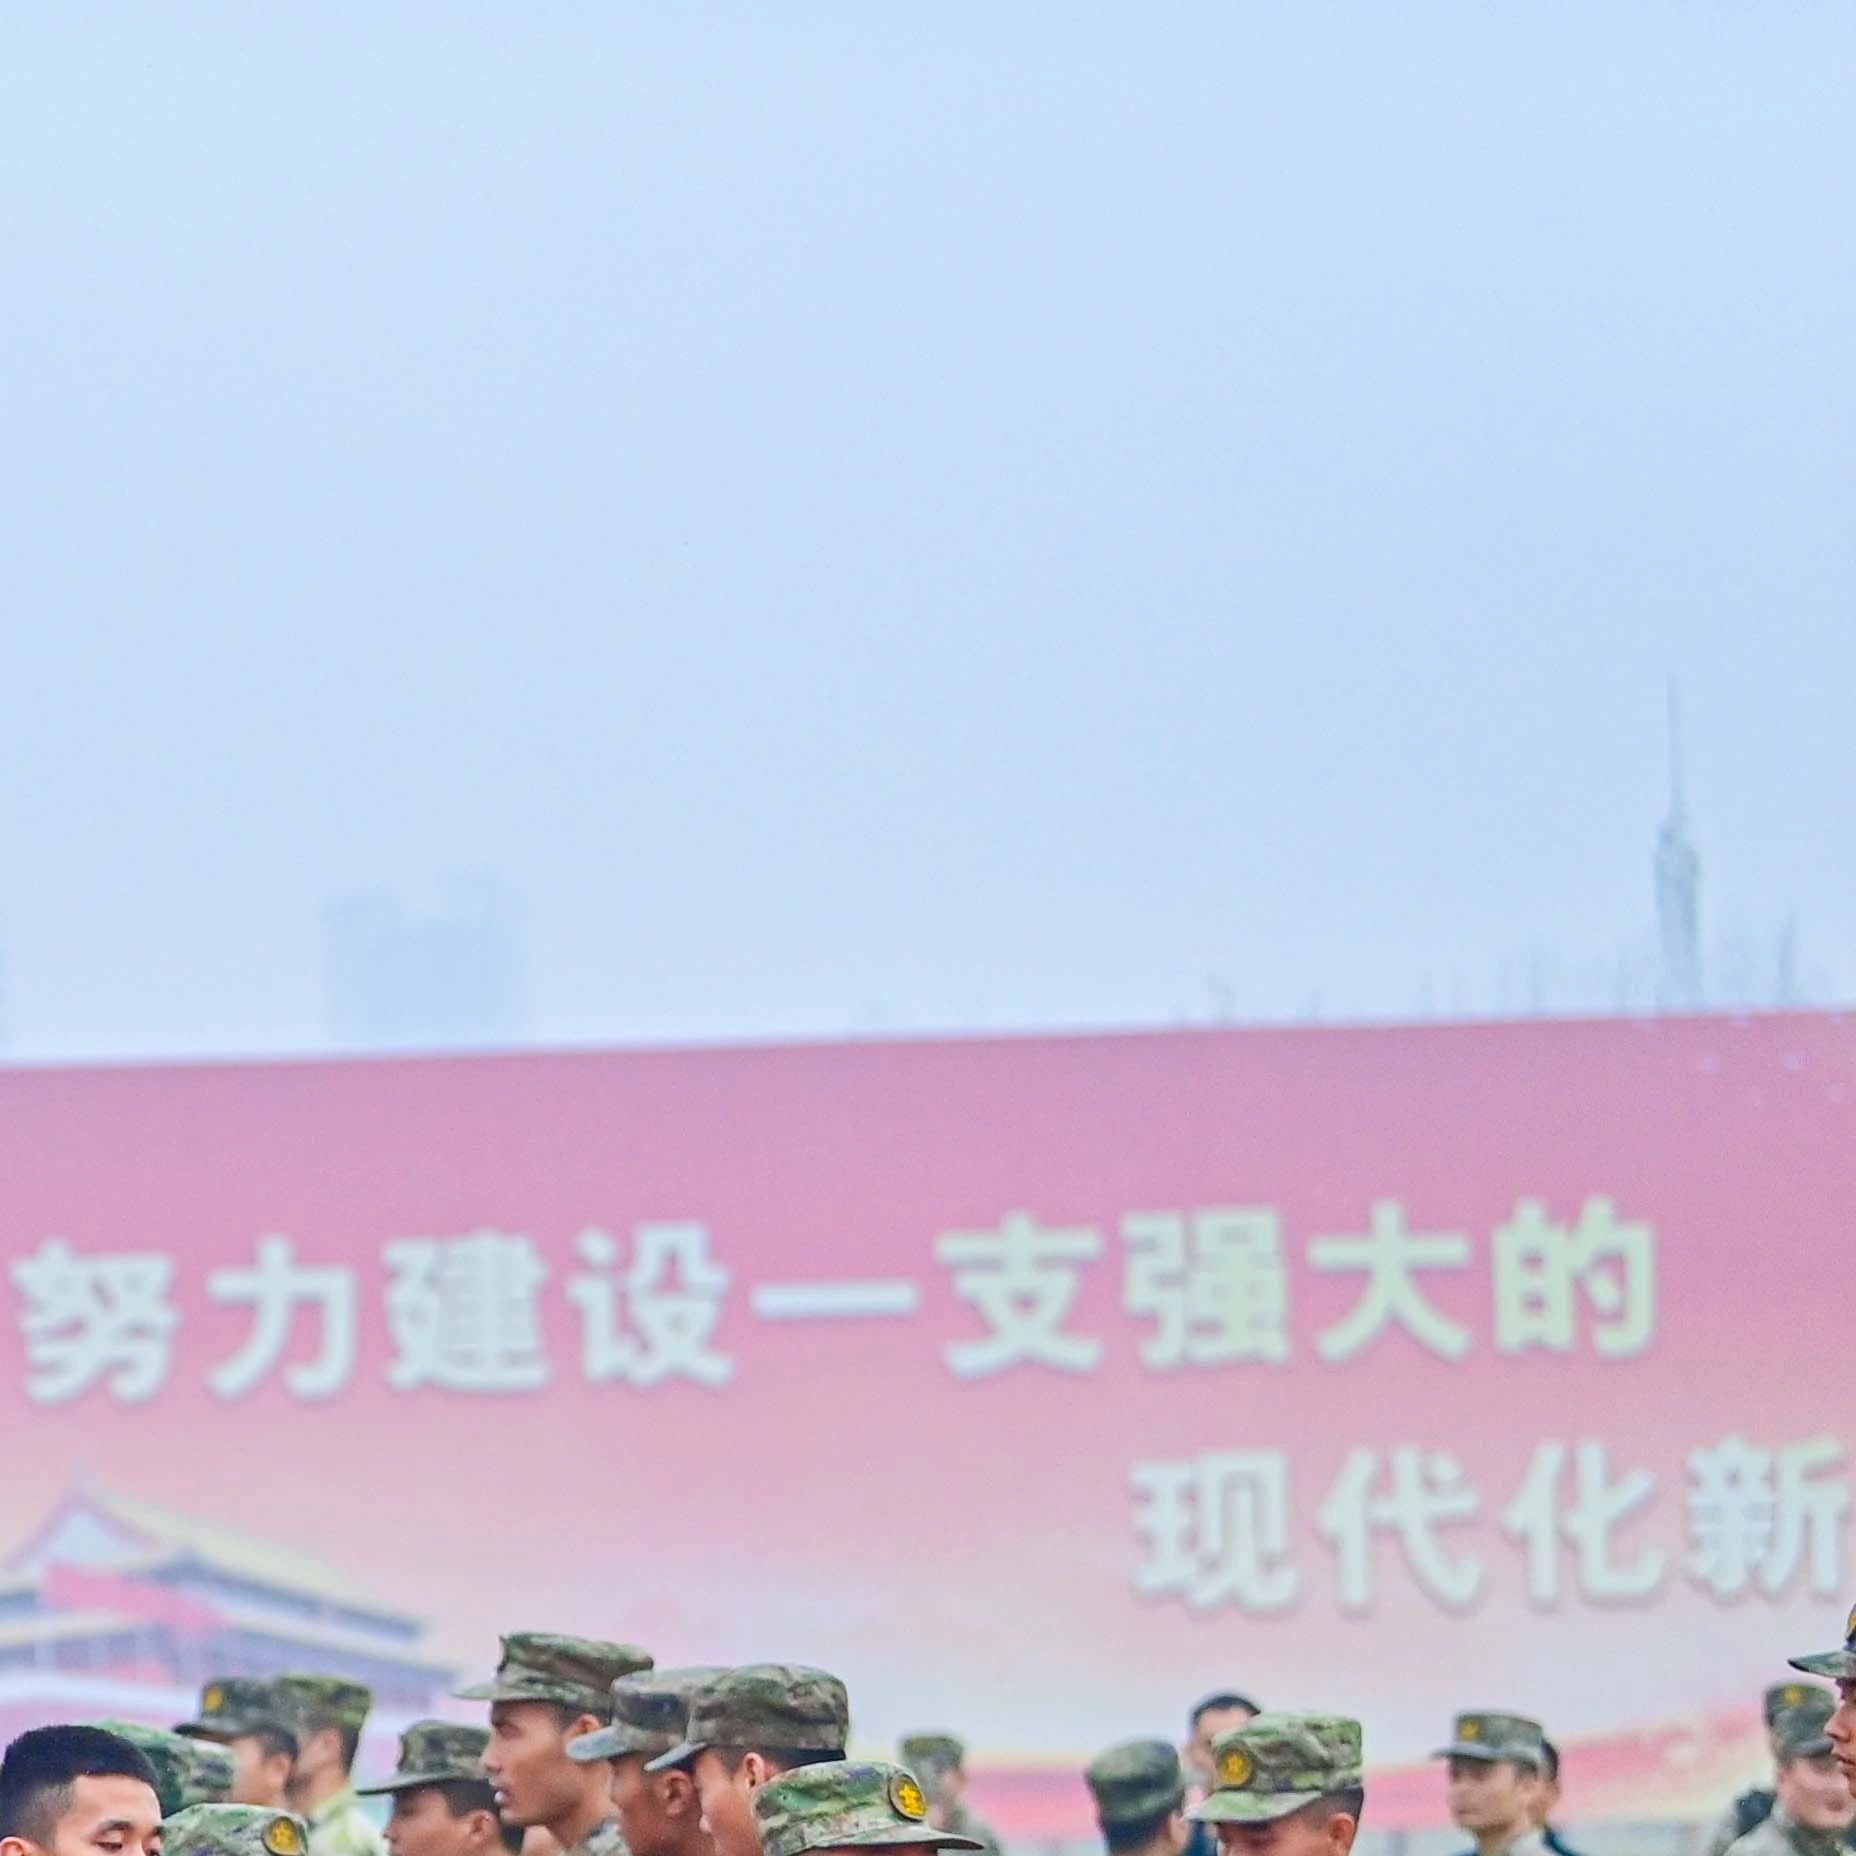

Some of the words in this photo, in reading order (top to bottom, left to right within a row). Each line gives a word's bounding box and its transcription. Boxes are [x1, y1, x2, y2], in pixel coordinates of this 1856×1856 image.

[10, 1196, 1658, 1401] 努力建设一支强大的
[1128, 1436, 1850, 1610] 现代化新
